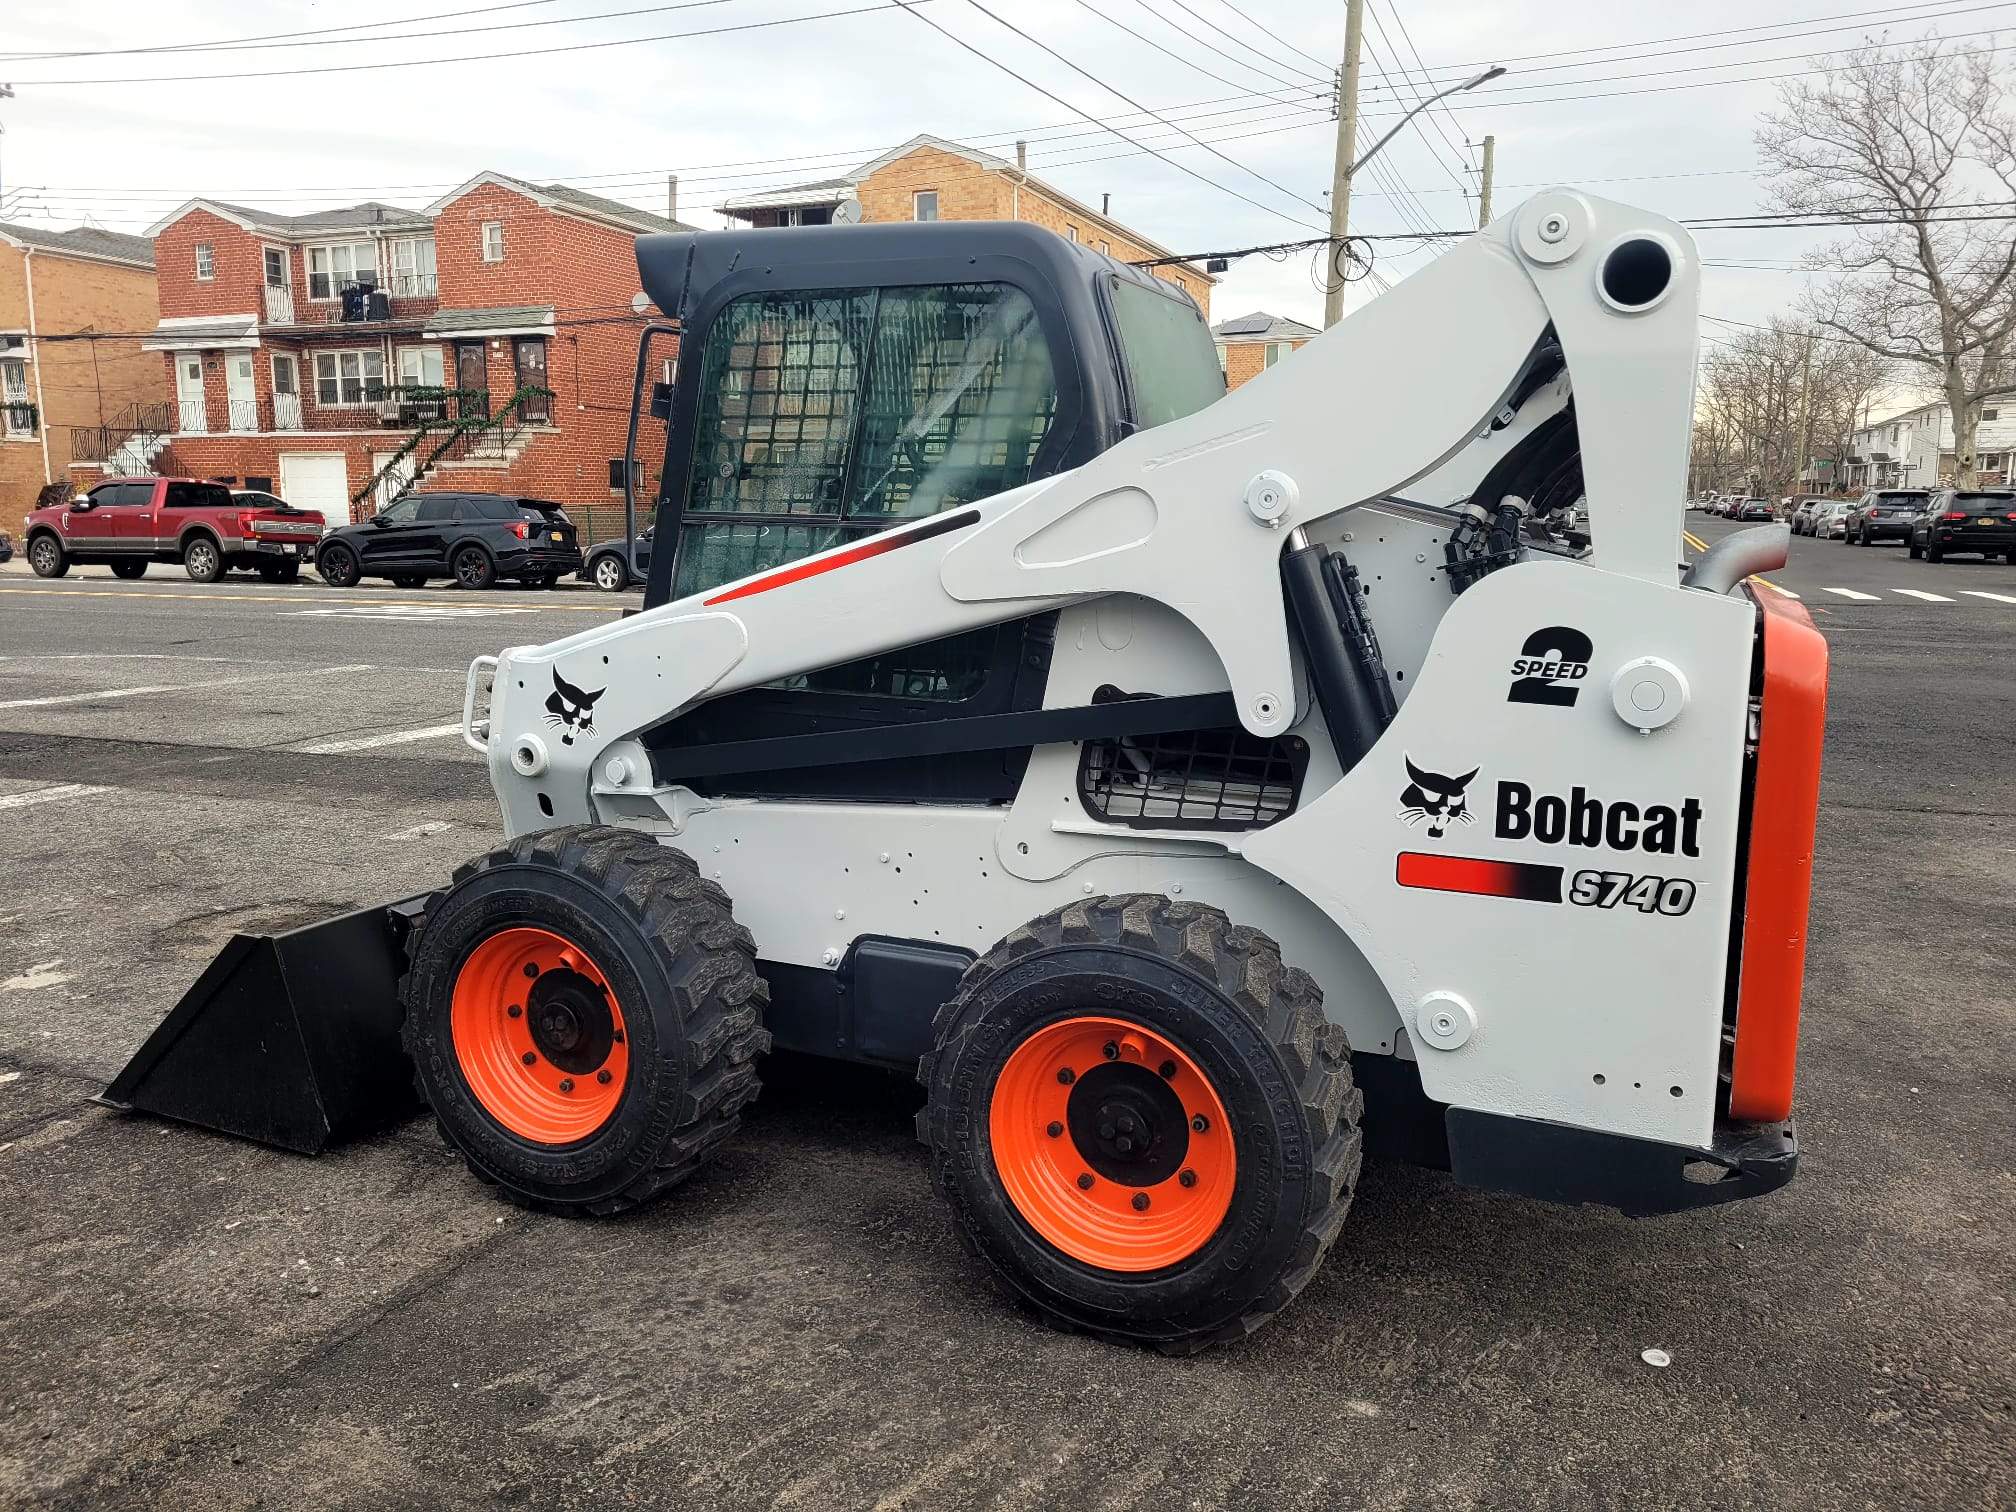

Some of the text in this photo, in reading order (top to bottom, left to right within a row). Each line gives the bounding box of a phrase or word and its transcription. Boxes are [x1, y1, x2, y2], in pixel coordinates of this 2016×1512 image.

[1507, 626, 1593, 707] 2
[1511, 659, 1588, 680] SPEED
[1495, 780, 1702, 858] Bobcat
[1569, 869, 1697, 917] S740
[1170, 977, 1302, 1182] SUPER TRACTION
